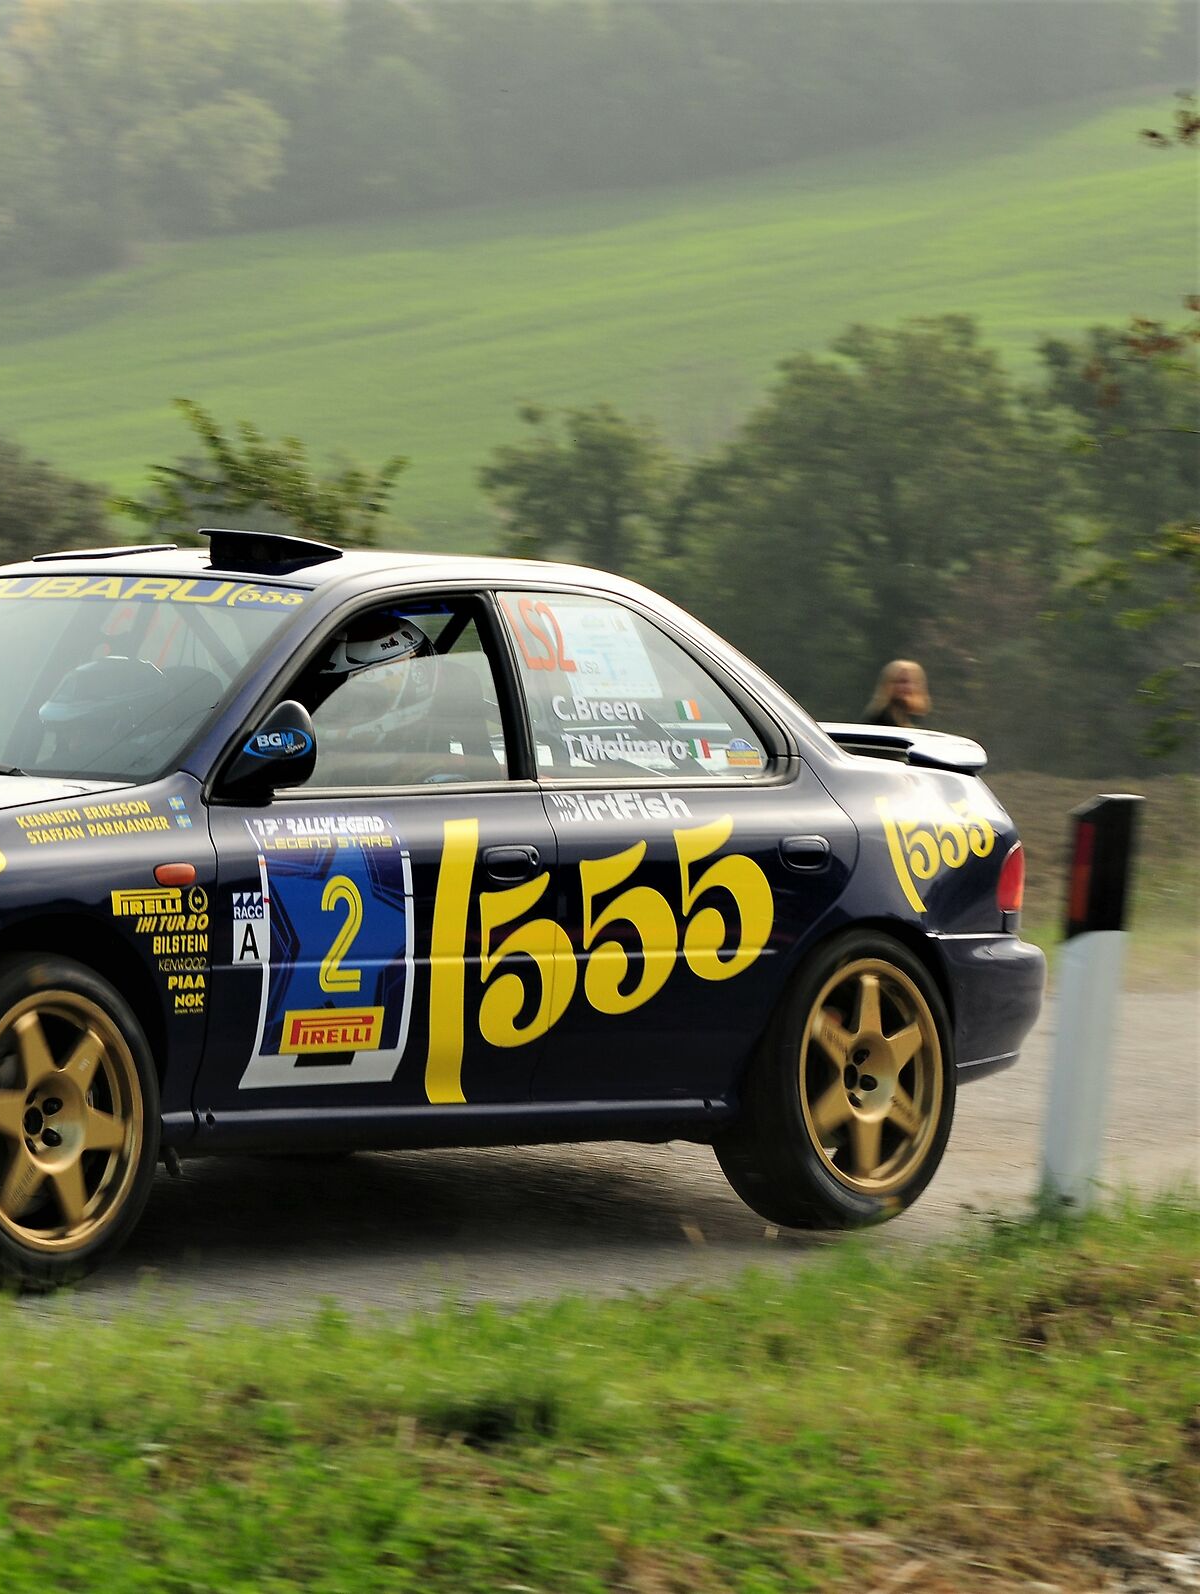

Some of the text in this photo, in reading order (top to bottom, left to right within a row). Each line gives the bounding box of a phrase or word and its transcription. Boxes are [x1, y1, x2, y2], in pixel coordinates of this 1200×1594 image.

[256, 732, 295, 748] BGM
[15, 800, 151, 830] KENNETH ERIKSSON
[26, 815, 171, 845] STAFFAN PARMANDER
[336, 835, 393, 849] STARS
[111, 888, 182, 916] PIRELLI
[233, 905, 263, 919] RACC
[158, 913, 209, 933] TURBO
[319, 874, 363, 993] 2
[479, 814, 774, 1049] 555
[153, 934, 208, 955] BILSTEIN
[239, 922, 260, 961] A
[158, 957, 207, 972] KENWOOD
[167, 974, 206, 990] PIAA
[174, 992, 205, 1008] NGK
[289, 1015, 374, 1045] PIRELLI
